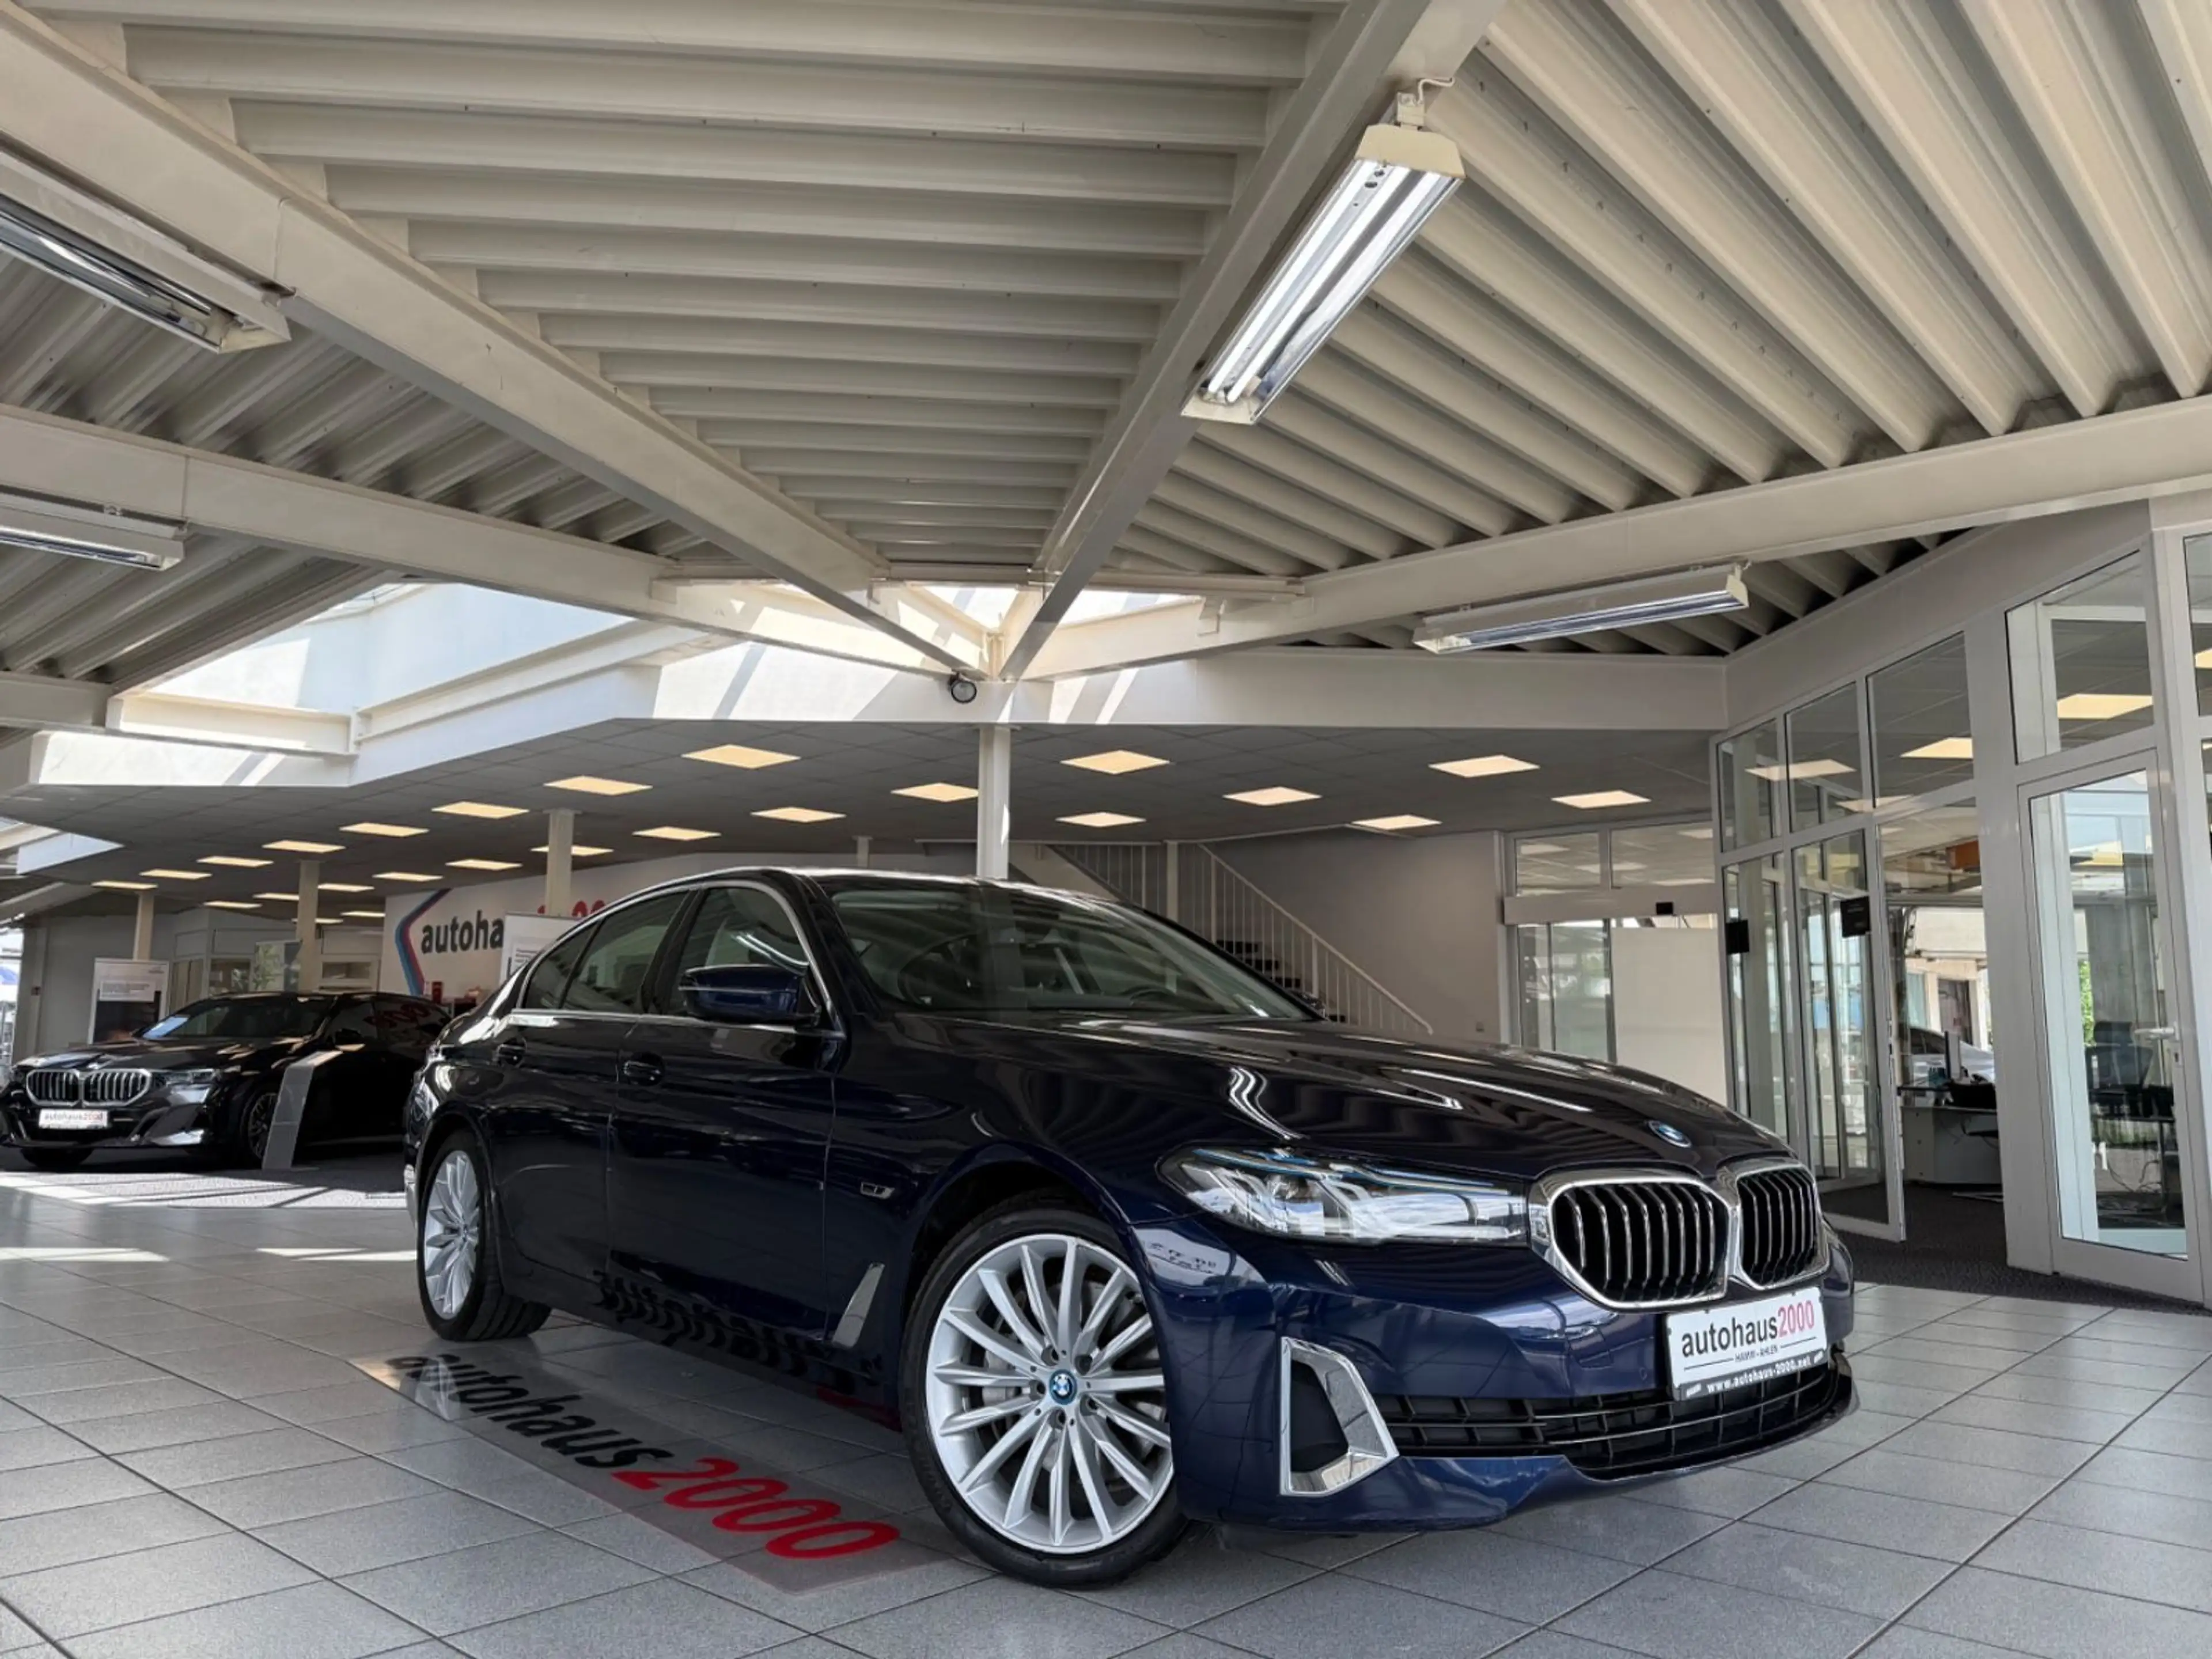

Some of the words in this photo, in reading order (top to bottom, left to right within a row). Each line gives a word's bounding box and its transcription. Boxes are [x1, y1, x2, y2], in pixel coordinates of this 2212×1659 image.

[421, 909, 503, 954] autoha
[1681, 1300, 1815, 1357] autohaus2000
[384, 1354, 900, 1559] autohaus2000
